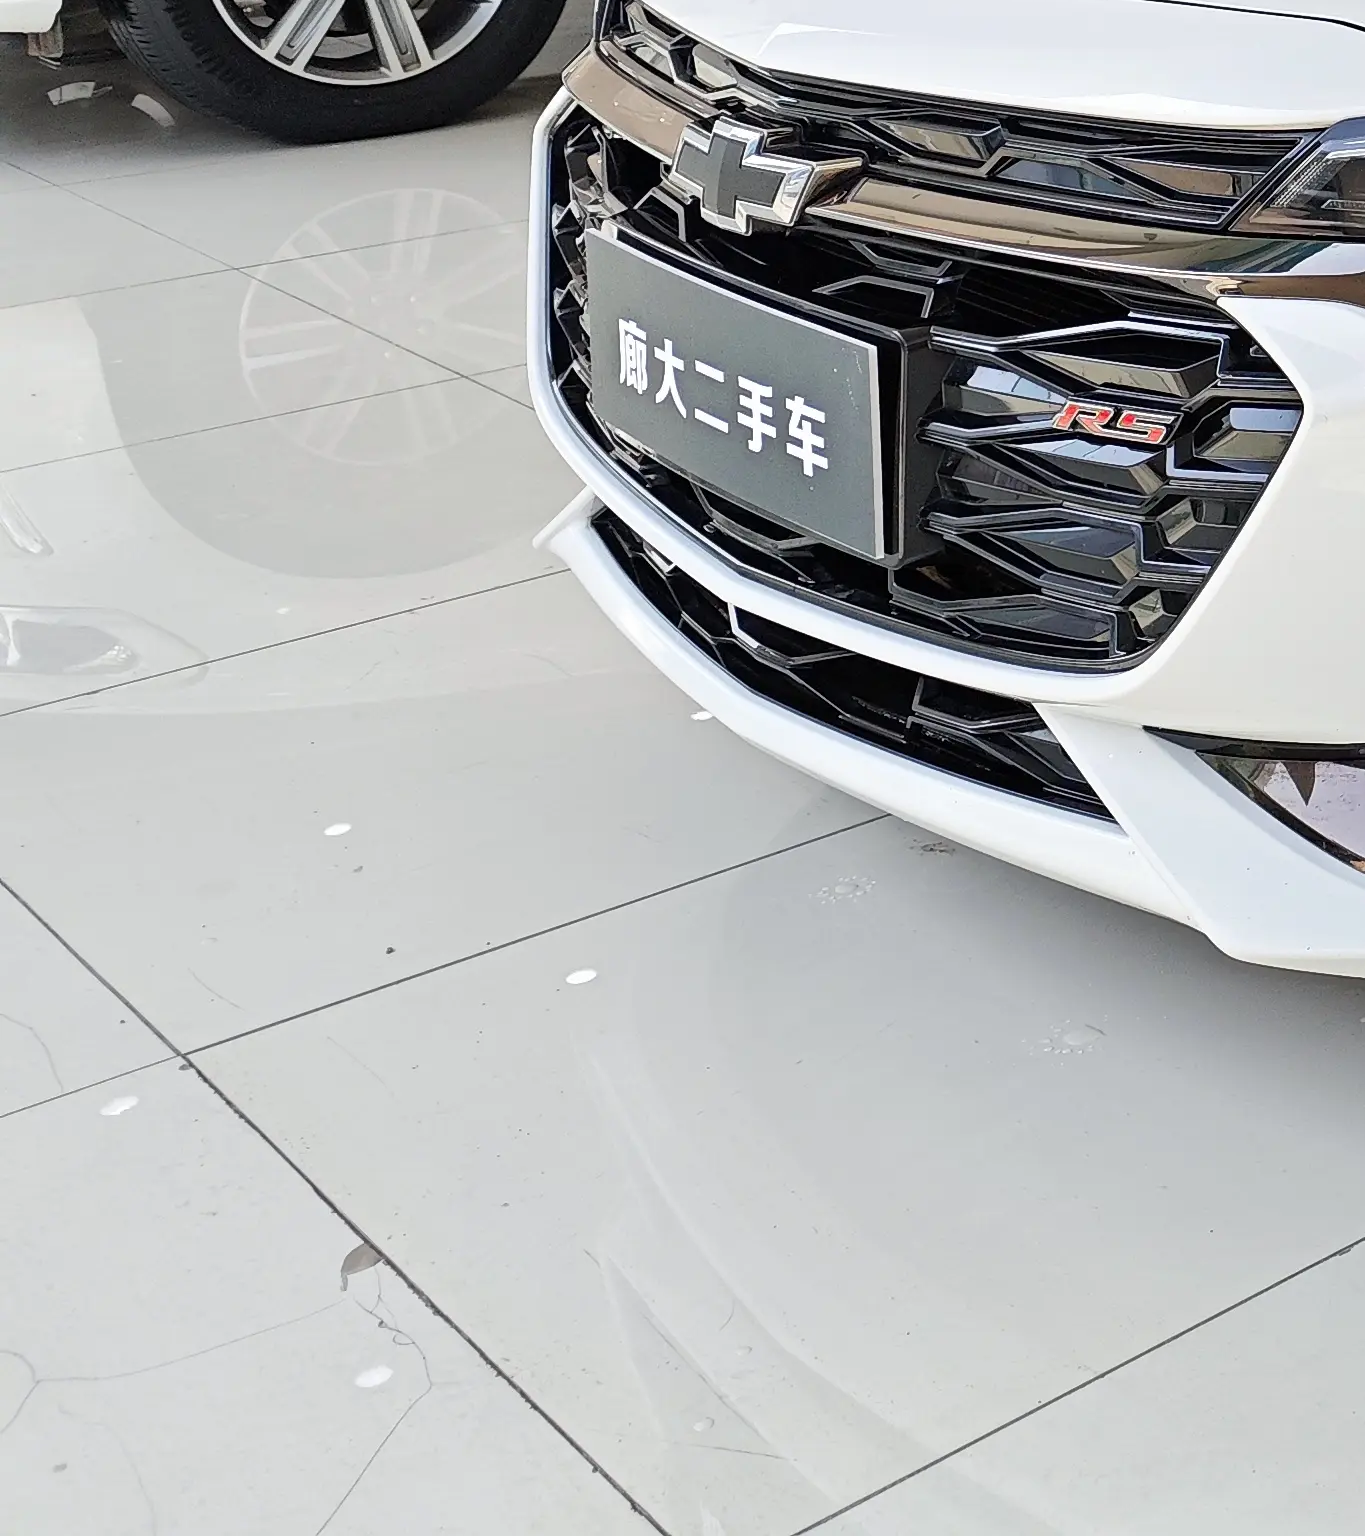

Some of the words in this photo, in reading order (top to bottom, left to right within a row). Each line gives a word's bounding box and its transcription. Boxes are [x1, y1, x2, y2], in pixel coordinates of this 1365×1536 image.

[617, 318, 830, 478] 廊大二手车
[1053, 398, 1181, 445] RS
